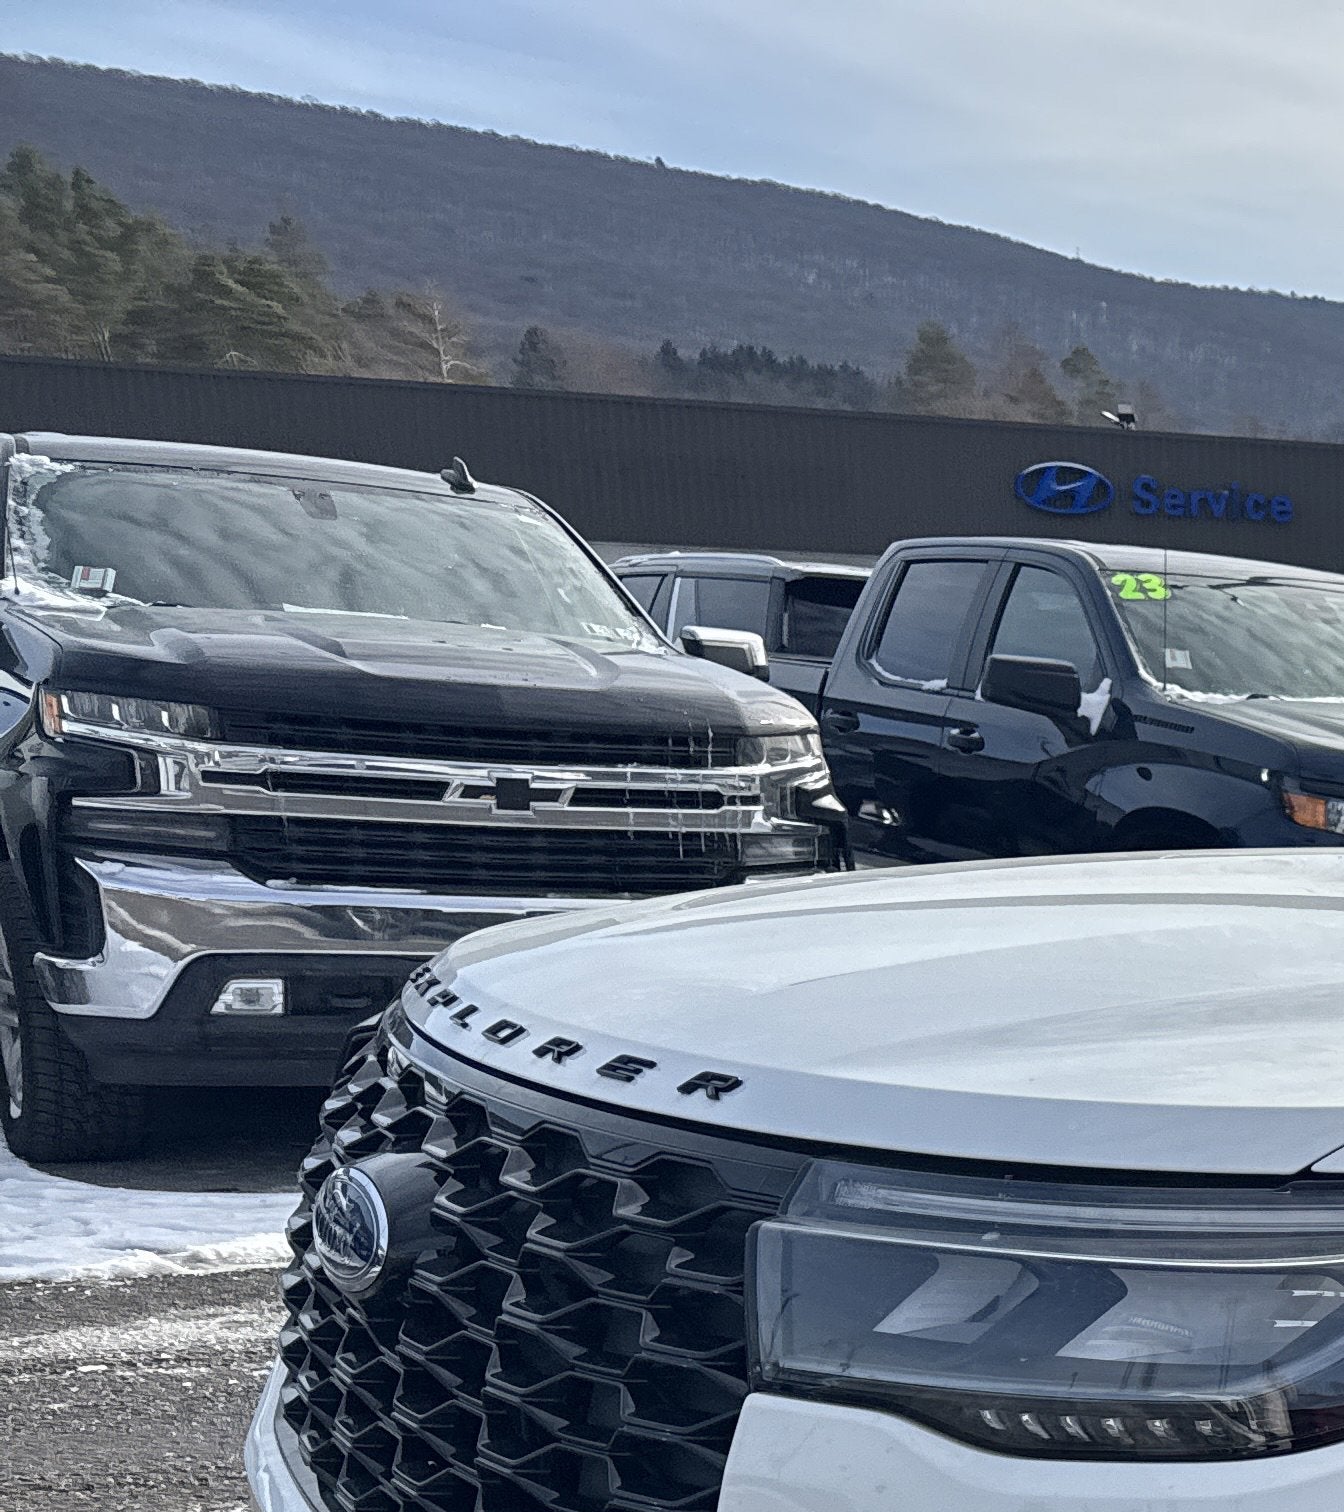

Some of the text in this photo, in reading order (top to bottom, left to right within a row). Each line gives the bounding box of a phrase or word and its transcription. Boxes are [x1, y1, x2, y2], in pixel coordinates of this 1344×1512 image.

[1131, 475, 1294, 524] Service
[1110, 572, 1172, 600] 23
[409, 966, 744, 1101] EXPLORER
